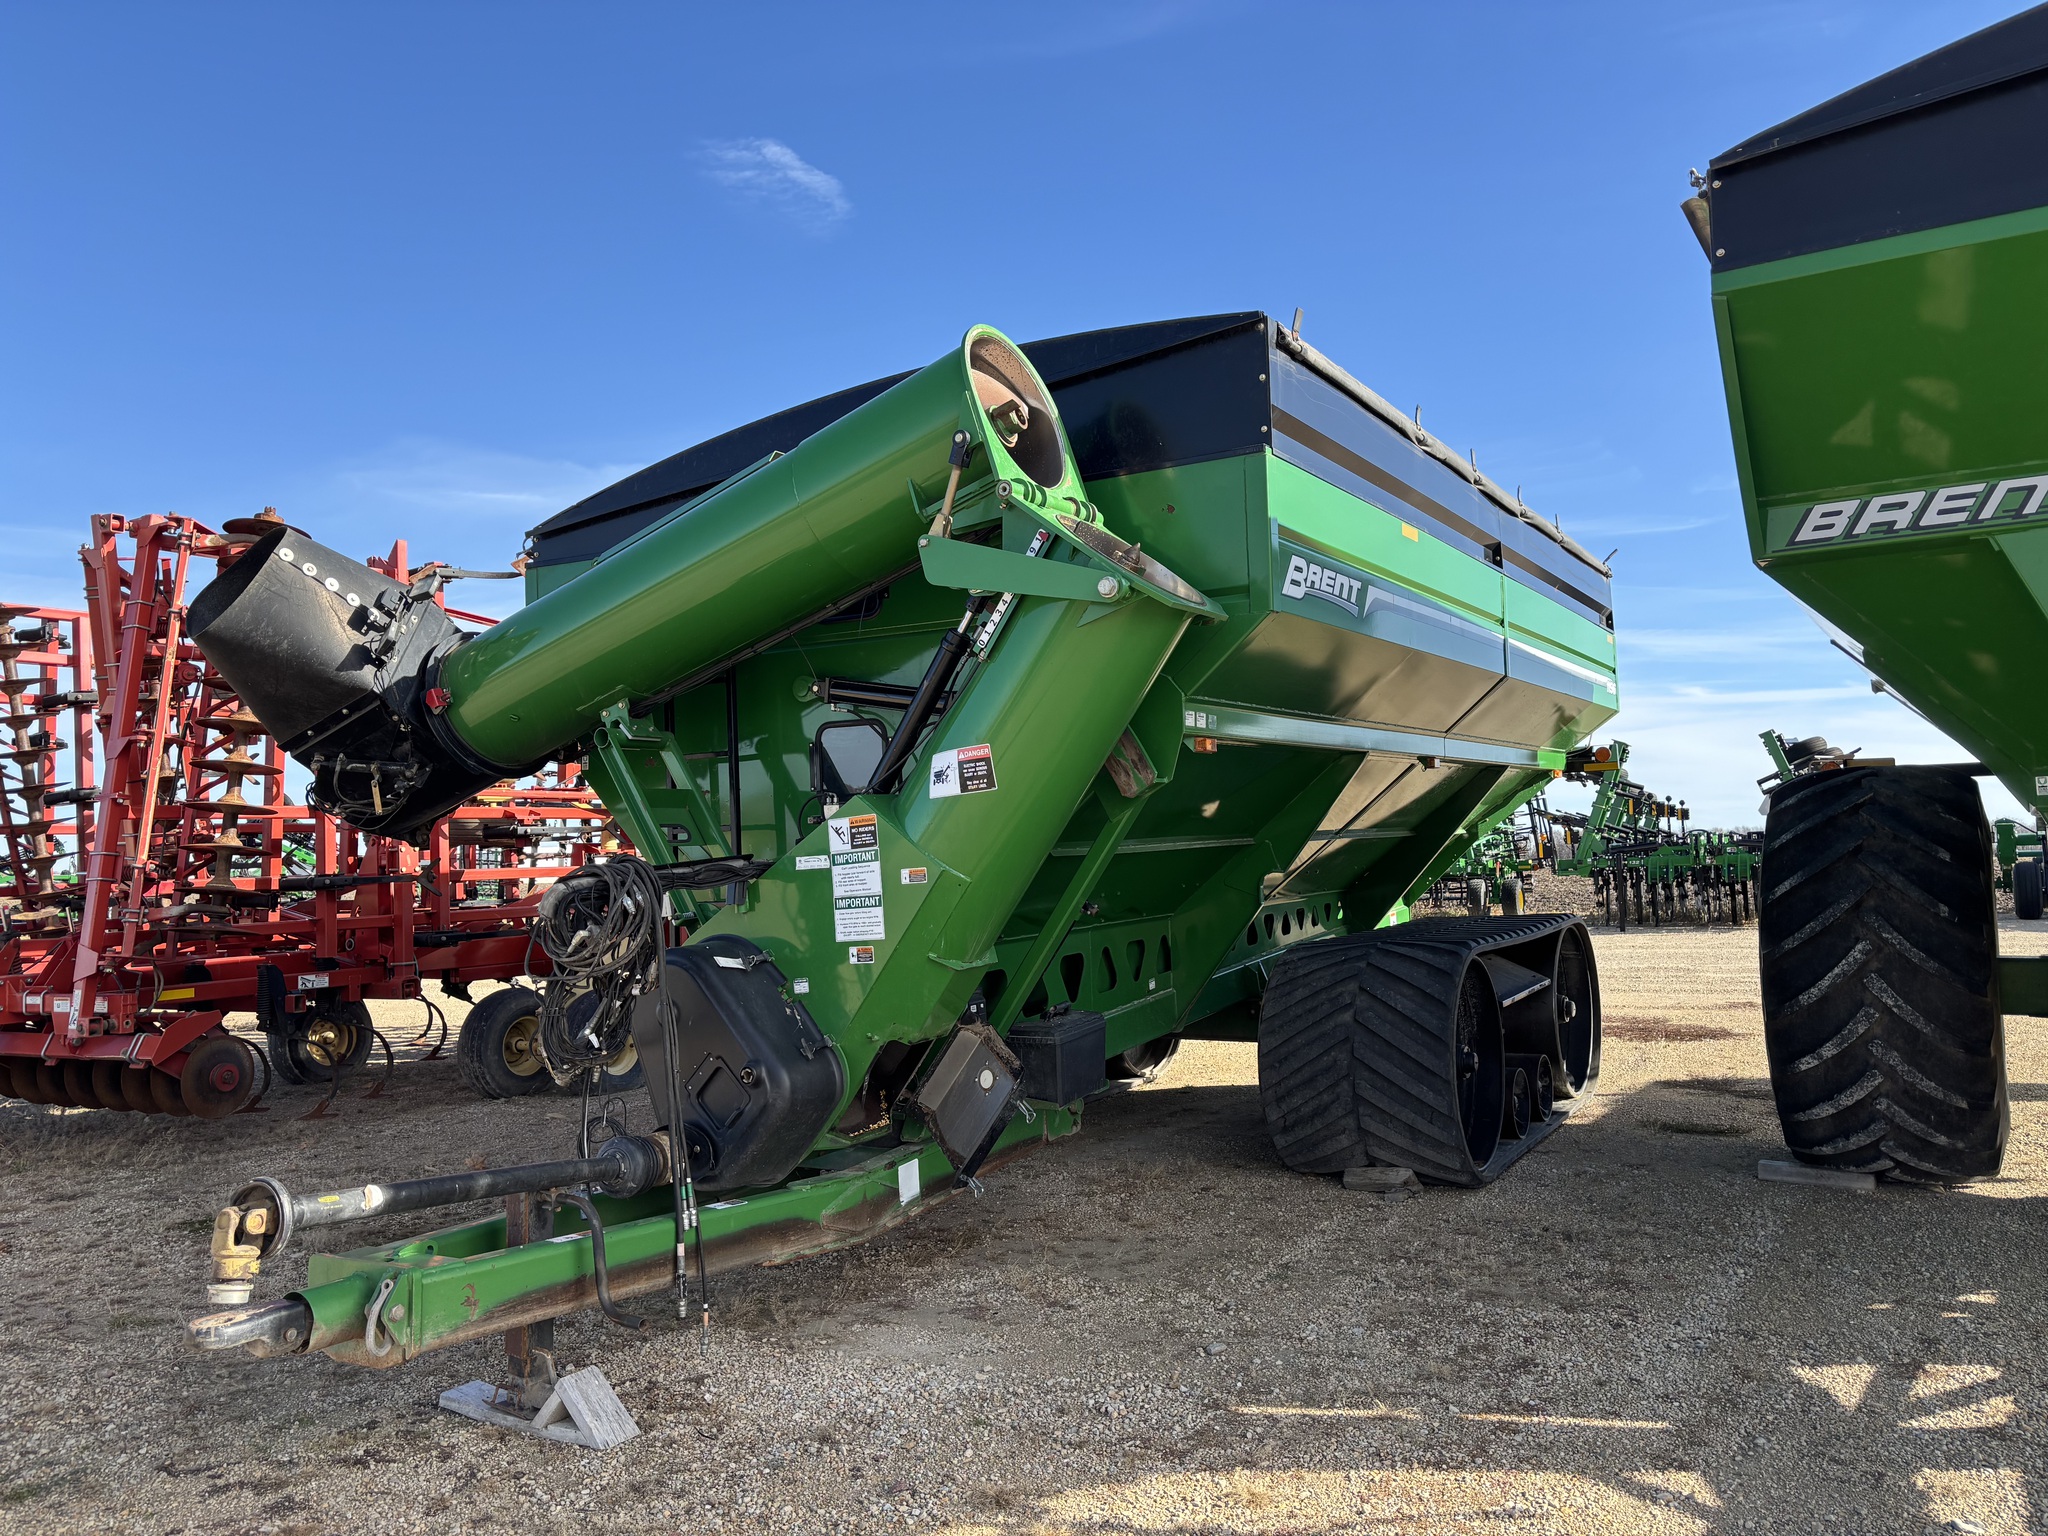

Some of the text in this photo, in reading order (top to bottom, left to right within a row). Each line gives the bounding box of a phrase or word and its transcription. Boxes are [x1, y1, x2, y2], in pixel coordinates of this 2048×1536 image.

[1281, 554, 1362, 606] BRENT
[989, 619, 997, 627] 2
[995, 608, 1003, 617] 3
[1001, 598, 1009, 606] 4
[964, 748, 989, 758] DANGER
[834, 851, 876, 864] IMPORTANT
[836, 896, 880, 909] IMPORTANT
